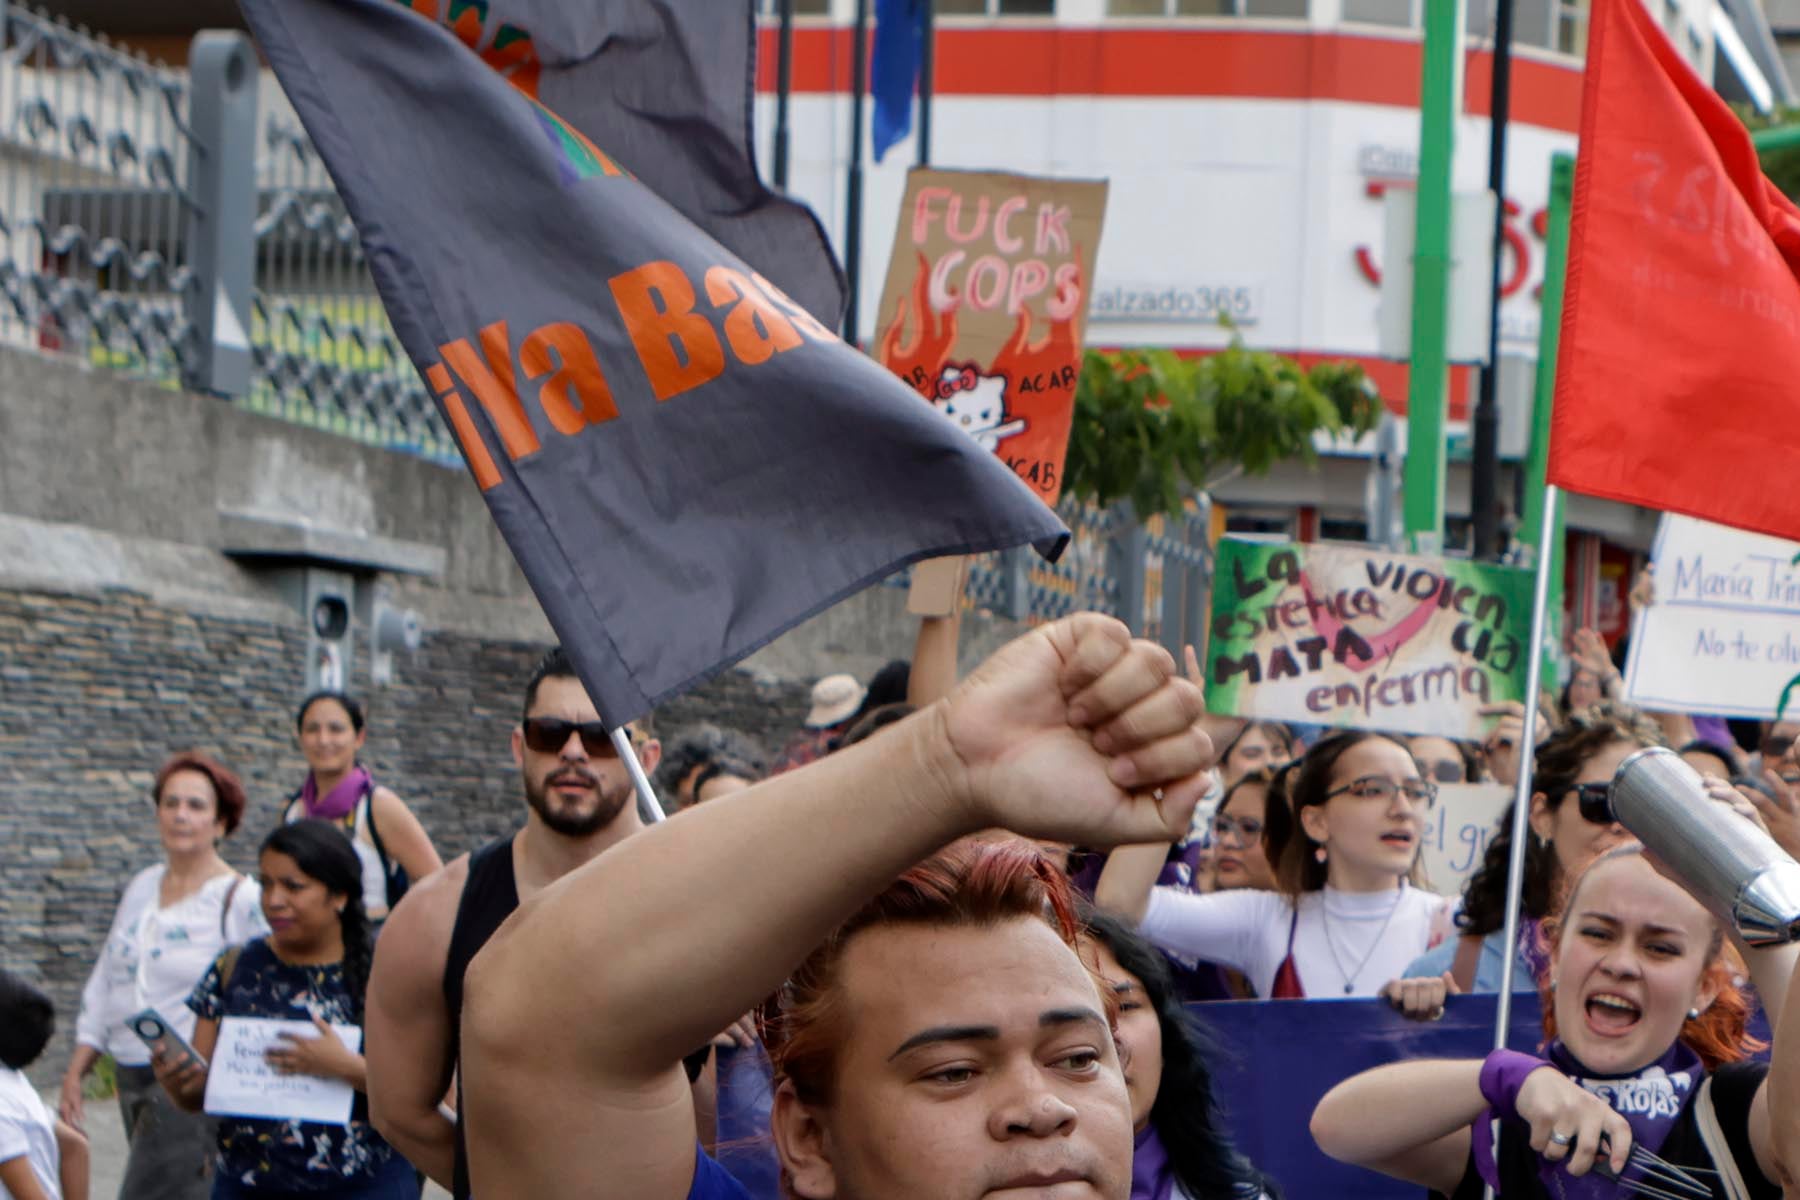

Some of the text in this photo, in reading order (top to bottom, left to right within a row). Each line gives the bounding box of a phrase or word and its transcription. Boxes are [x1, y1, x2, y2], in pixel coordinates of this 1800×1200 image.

[912, 187, 1071, 255] FUCK
[928, 251, 1082, 321] COPS
[426, 320, 620, 492] ¡Ya
[1019, 366, 1077, 394] ACAB
[1674, 553, 1753, 600] María
[1215, 626, 1373, 685] MATA
[1694, 628, 1725, 657] No
[1731, 631, 1761, 664] te
[1306, 662, 1489, 716] enferma
